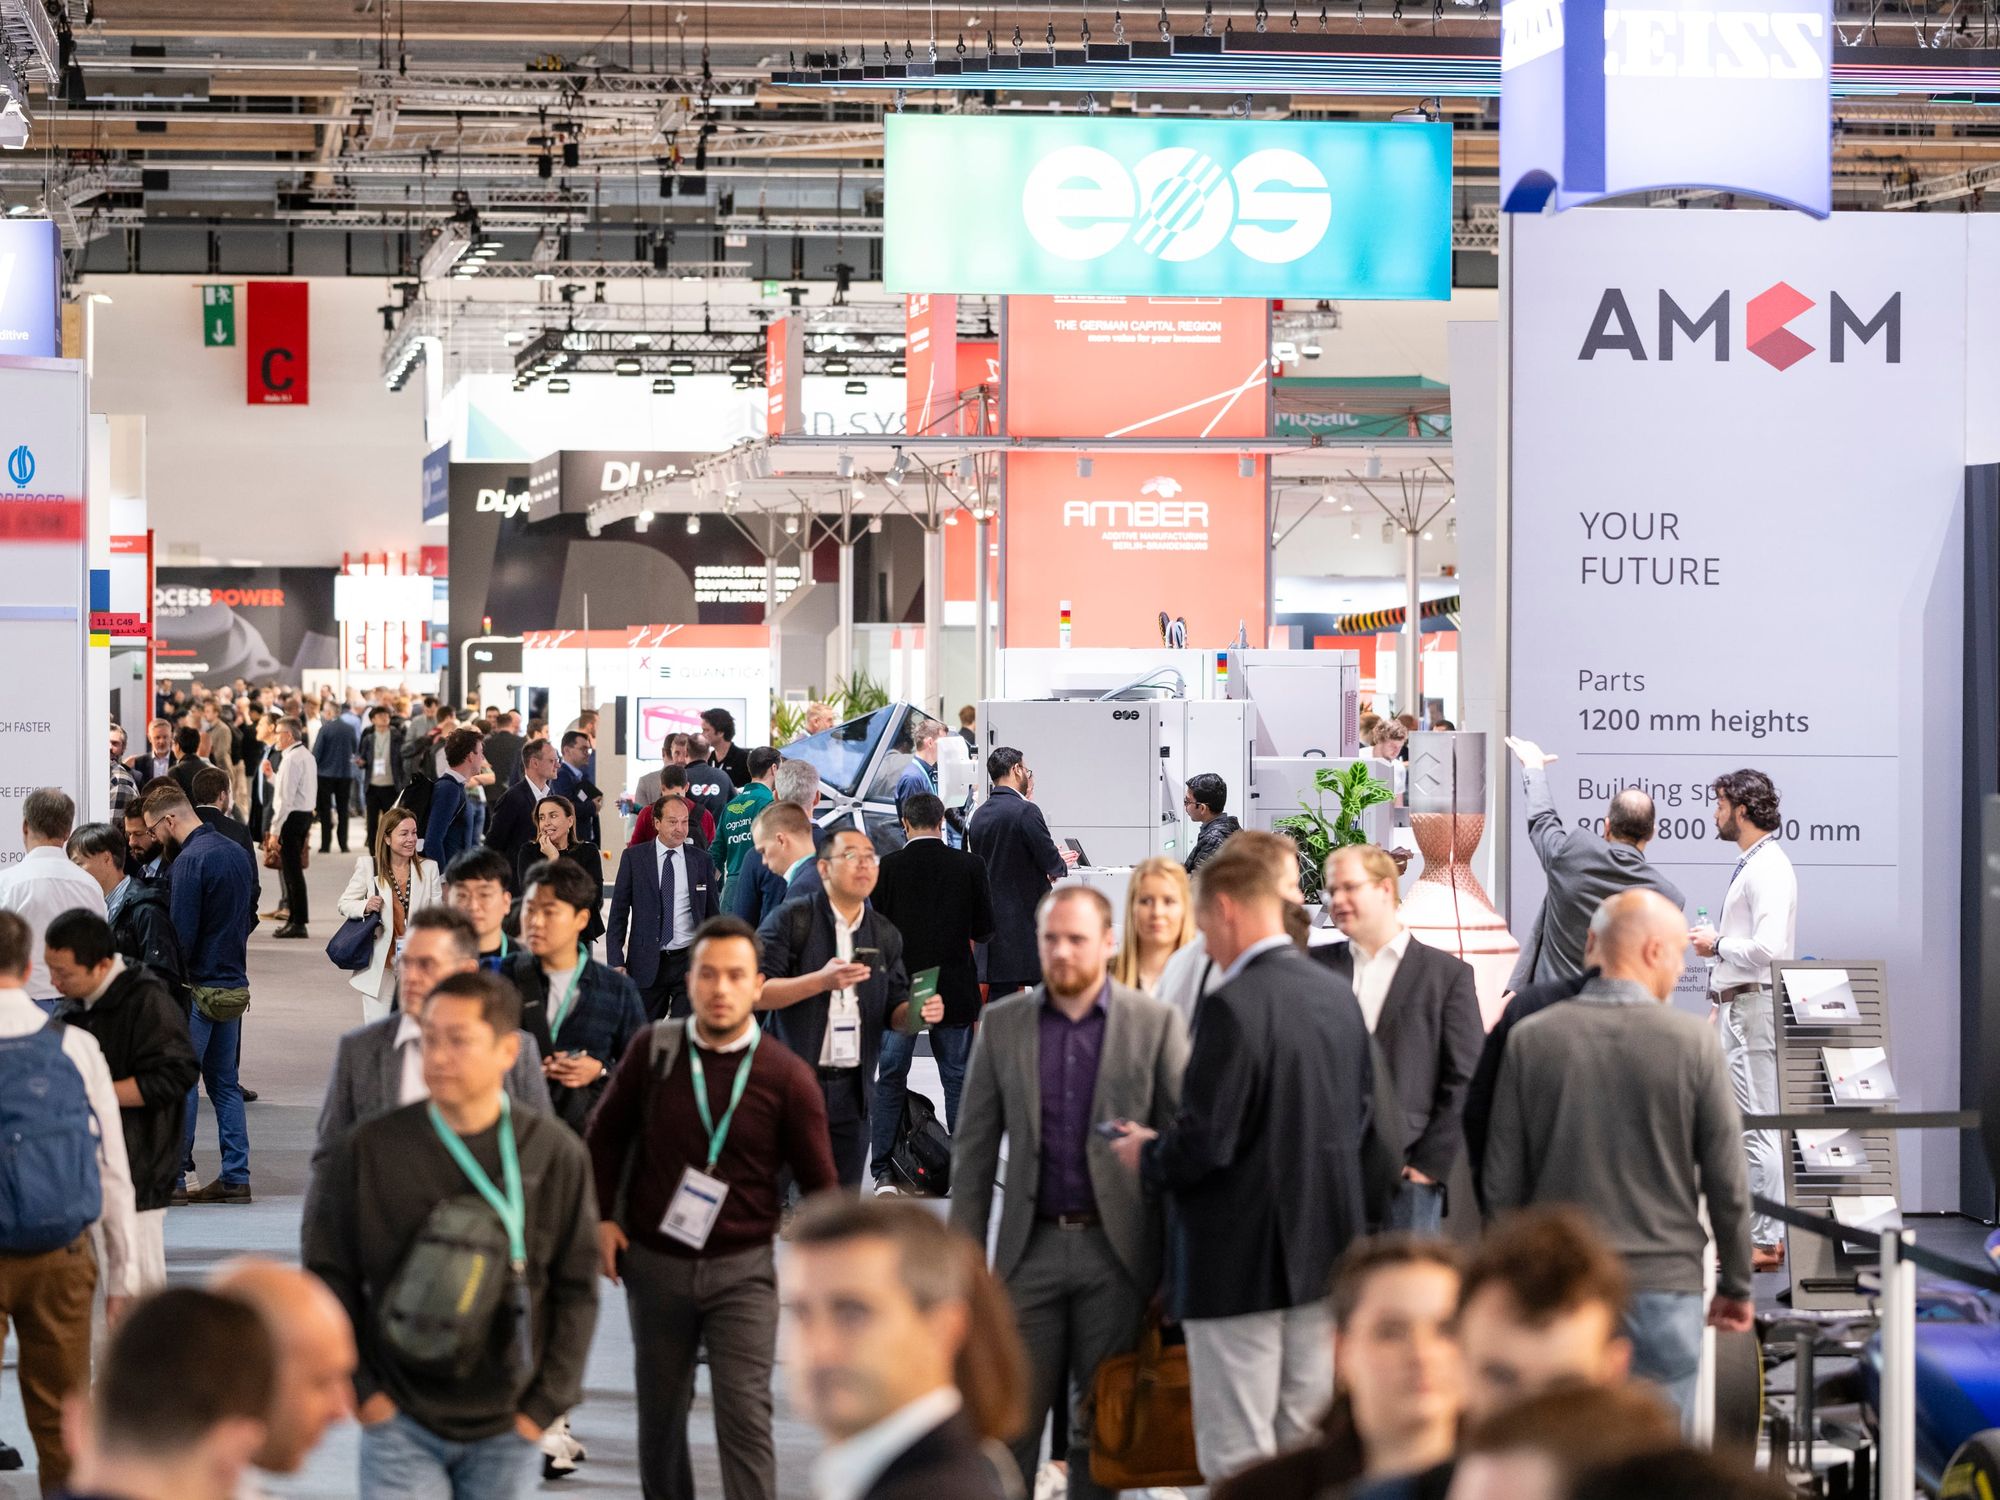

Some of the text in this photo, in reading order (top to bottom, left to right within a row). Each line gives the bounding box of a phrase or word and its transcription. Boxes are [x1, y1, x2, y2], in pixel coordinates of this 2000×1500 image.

[1604, 9, 1823, 79] EISS
[1022, 145, 1332, 264] eos
[1055, 320, 1221, 332] THE GERMAN CAPITAL REGION
[1578, 281, 1901, 372] AMCM
[262, 347, 294, 392] C
[1064, 501, 1209, 528] AMBER
[1580, 512, 1680, 541] YOUR
[1582, 557, 1720, 586] FUTURE
[97, 618, 133, 626] 11.1 C49
[1578, 669, 1646, 692] Parts
[14, 721, 51, 733] FASTER
[1112, 710, 1140, 721] eos
[1578, 709, 1810, 738] 1200 mm heights
[1658, 818, 1706, 840] 800
[1810, 824, 1860, 841] mm
